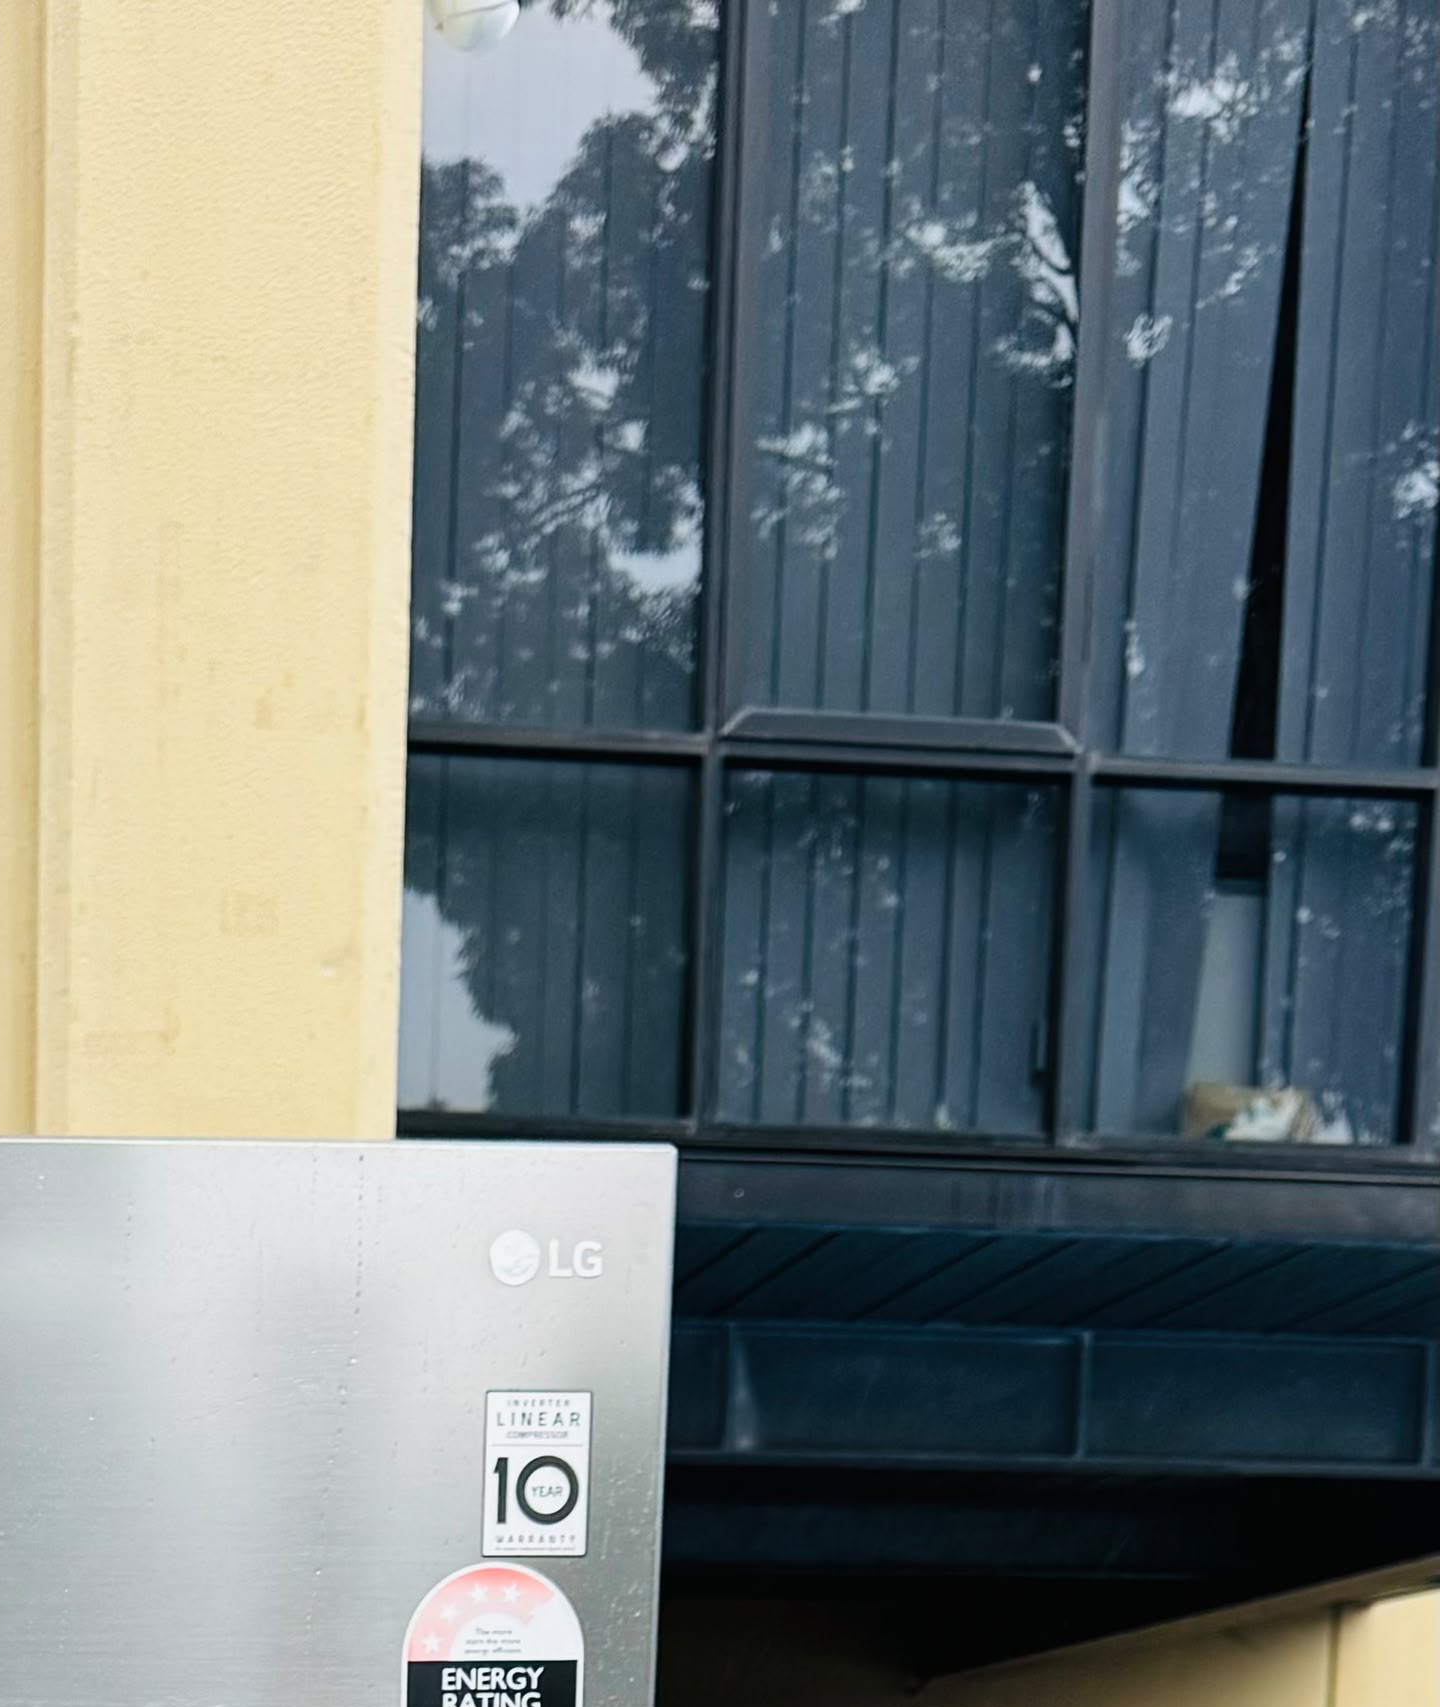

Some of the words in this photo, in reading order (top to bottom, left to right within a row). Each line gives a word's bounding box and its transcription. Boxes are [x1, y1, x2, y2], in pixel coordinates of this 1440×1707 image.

[548, 1238, 603, 1279] LG
[496, 1411, 581, 1427] LINEAR
[493, 1454, 580, 1526] 10
[530, 1485, 564, 1497] YEAR
[495, 1534, 577, 1544] WARRANTY
[441, 1666, 545, 1691] ENERGY
